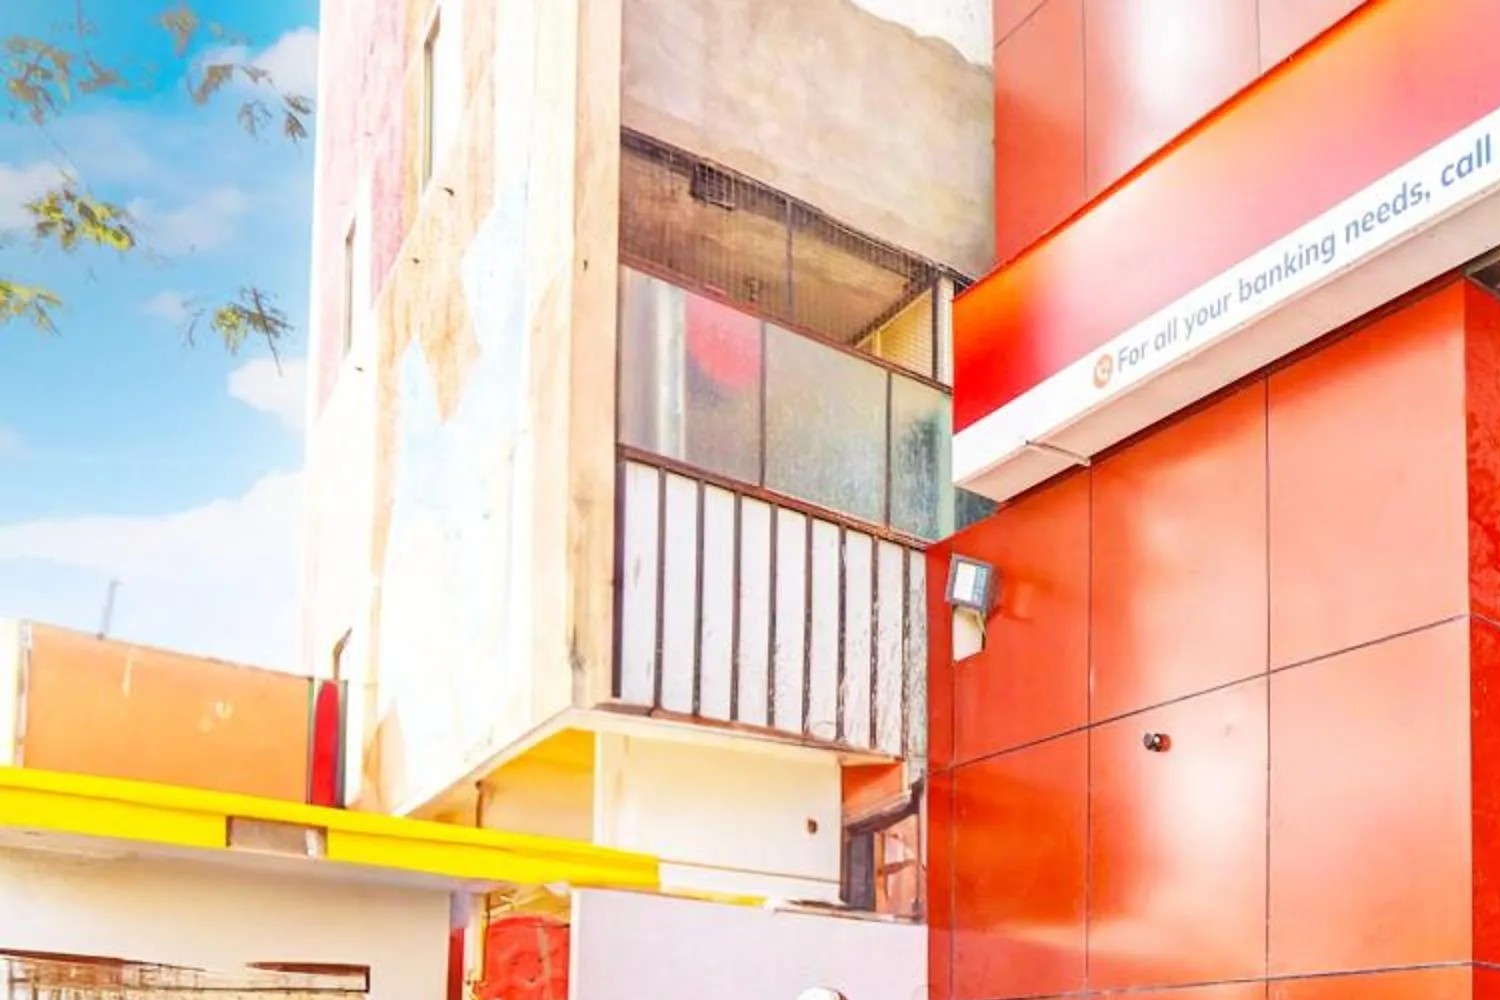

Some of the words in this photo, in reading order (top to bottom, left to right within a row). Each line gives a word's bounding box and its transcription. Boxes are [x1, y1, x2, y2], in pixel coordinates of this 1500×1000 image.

[1117, 342, 1149, 374] For
[1154, 316, 1177, 351] all
[1184, 291, 1232, 341] your
[1238, 231, 1336, 304] banking
[1344, 181, 1431, 244] needs,
[1441, 133, 1492, 188] call
